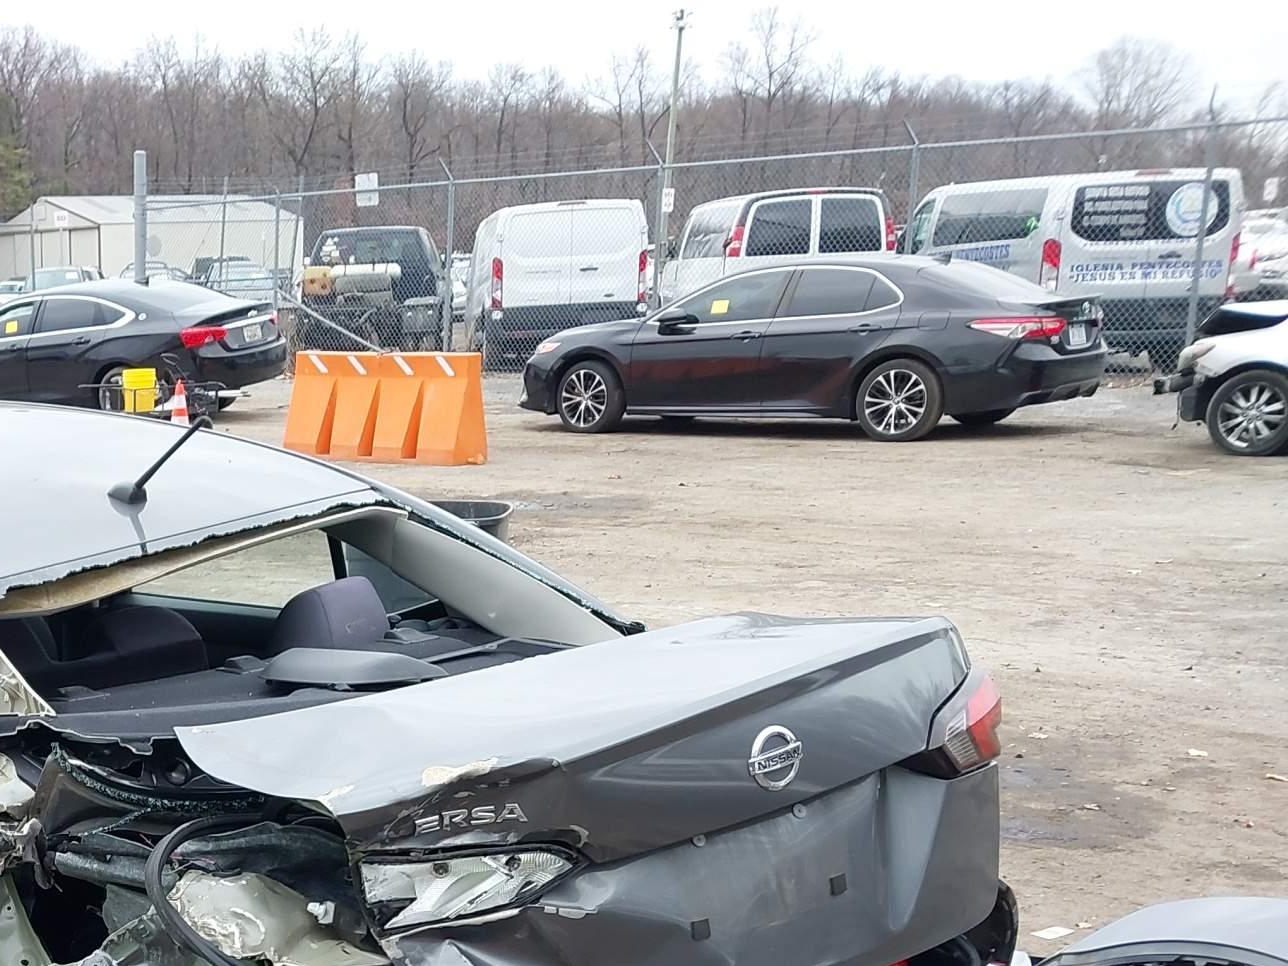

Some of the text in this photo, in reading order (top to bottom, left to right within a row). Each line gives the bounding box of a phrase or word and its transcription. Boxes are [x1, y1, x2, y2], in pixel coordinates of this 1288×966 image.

[1070, 263, 1123, 272] IGLESIA
[1120, 271, 1136, 281] ES
[1141, 270, 1157, 280] MI
[756, 748, 800, 771] NISSAN
[414, 803, 528, 837] ERSA
